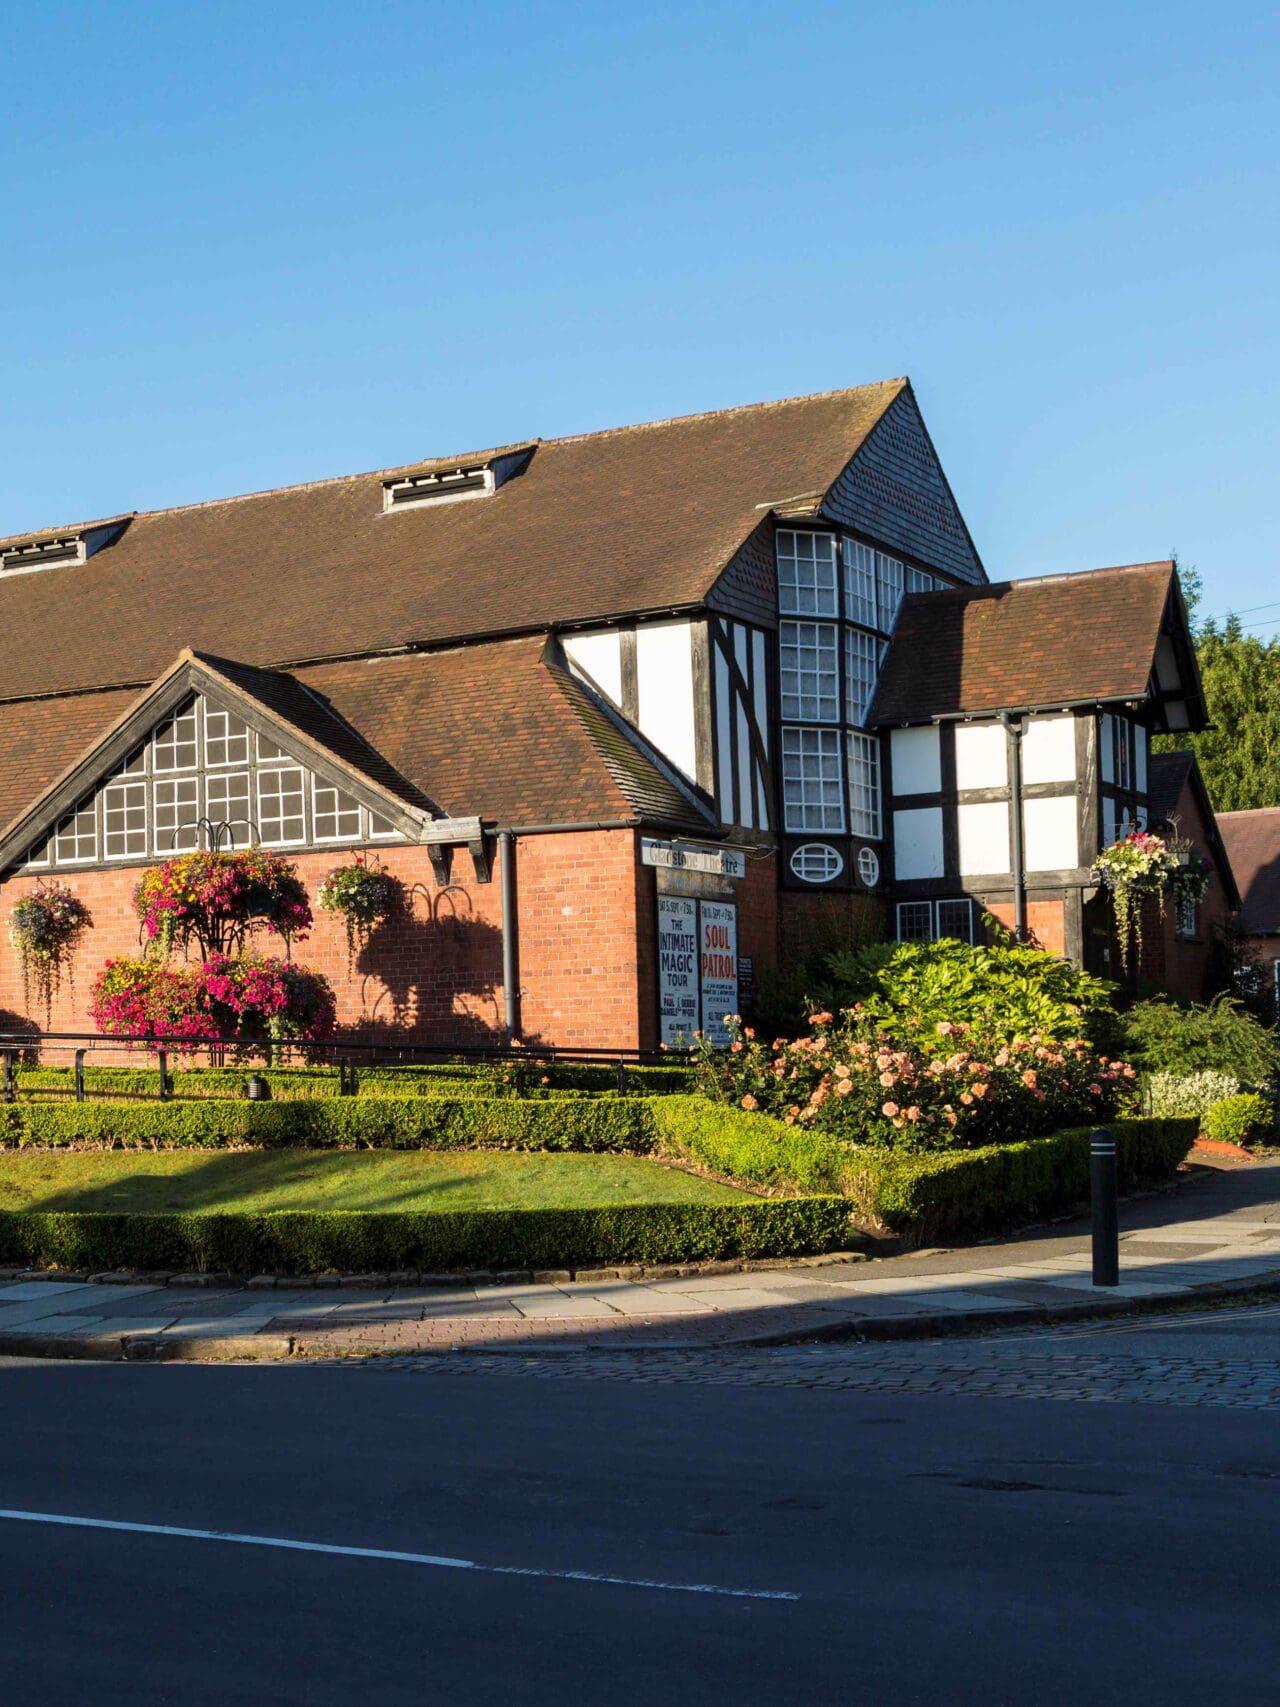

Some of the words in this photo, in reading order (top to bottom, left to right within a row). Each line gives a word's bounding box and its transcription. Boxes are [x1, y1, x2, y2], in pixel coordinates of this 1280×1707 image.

[650, 843, 698, 868] Gladstone
[702, 850, 738, 874] Theatre
[671, 919, 683, 931] THE
[660, 932, 695, 953] INTIMATE
[705, 925, 731, 950] SOUL
[661, 953, 693, 973] MAGIC
[701, 953, 736, 978] PATROL
[667, 973, 688, 987] TOUR
